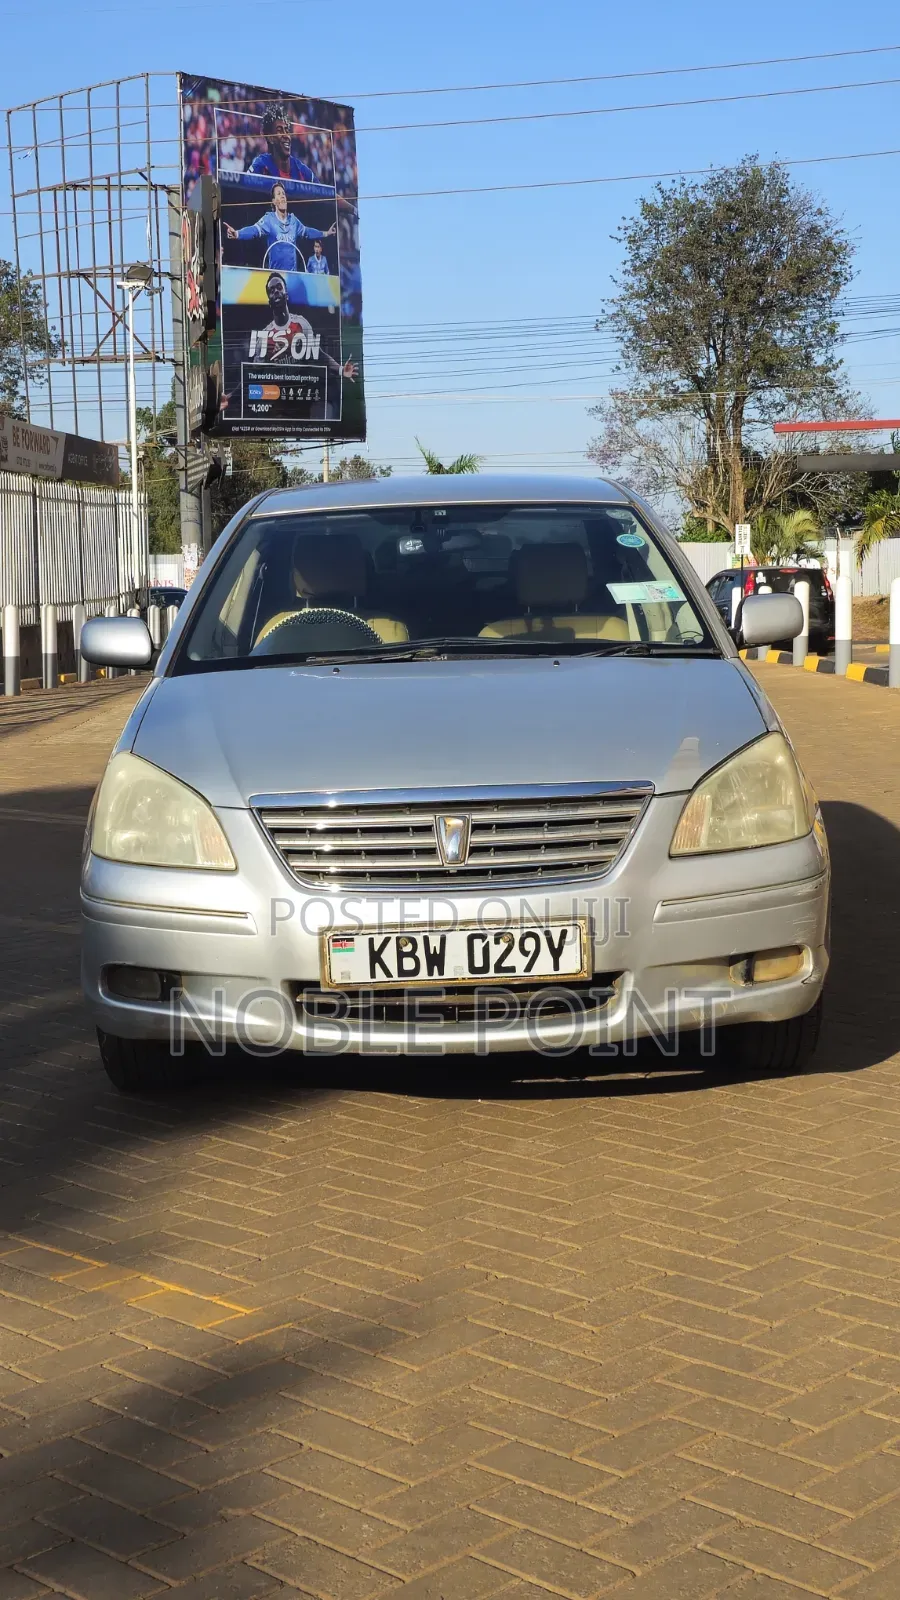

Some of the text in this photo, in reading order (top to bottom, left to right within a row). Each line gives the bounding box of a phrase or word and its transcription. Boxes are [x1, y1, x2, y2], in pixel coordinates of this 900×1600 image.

[248, 329, 320, 360] IT'S ON
[248, 372, 319, 384] The world's best football package
[12, 425, 20, 448] BE
[21, 427, 51, 456] FORWARD
[368, 928, 568, 980] KBW 029Y
